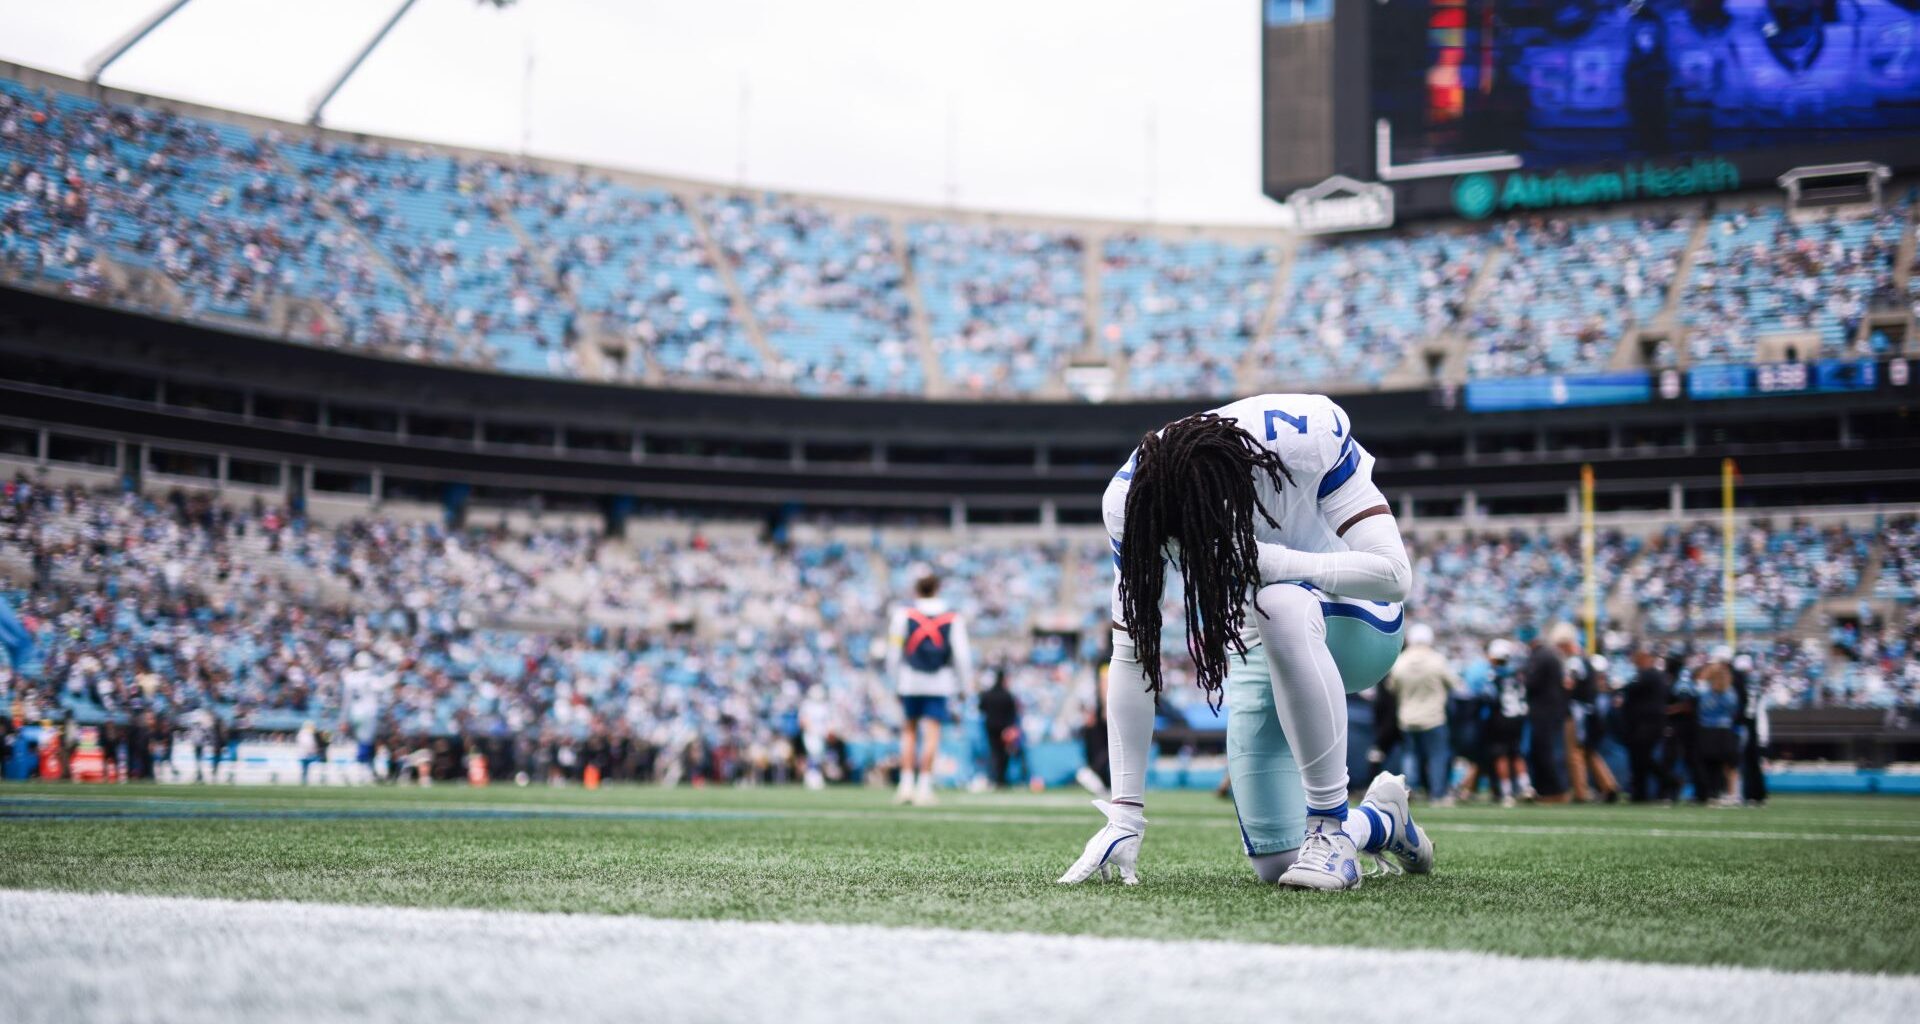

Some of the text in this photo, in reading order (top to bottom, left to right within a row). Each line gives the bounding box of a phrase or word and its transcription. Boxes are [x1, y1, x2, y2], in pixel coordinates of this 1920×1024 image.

[1502, 158, 1738, 207] Atrium Health
[1264, 409, 1308, 442] 7
